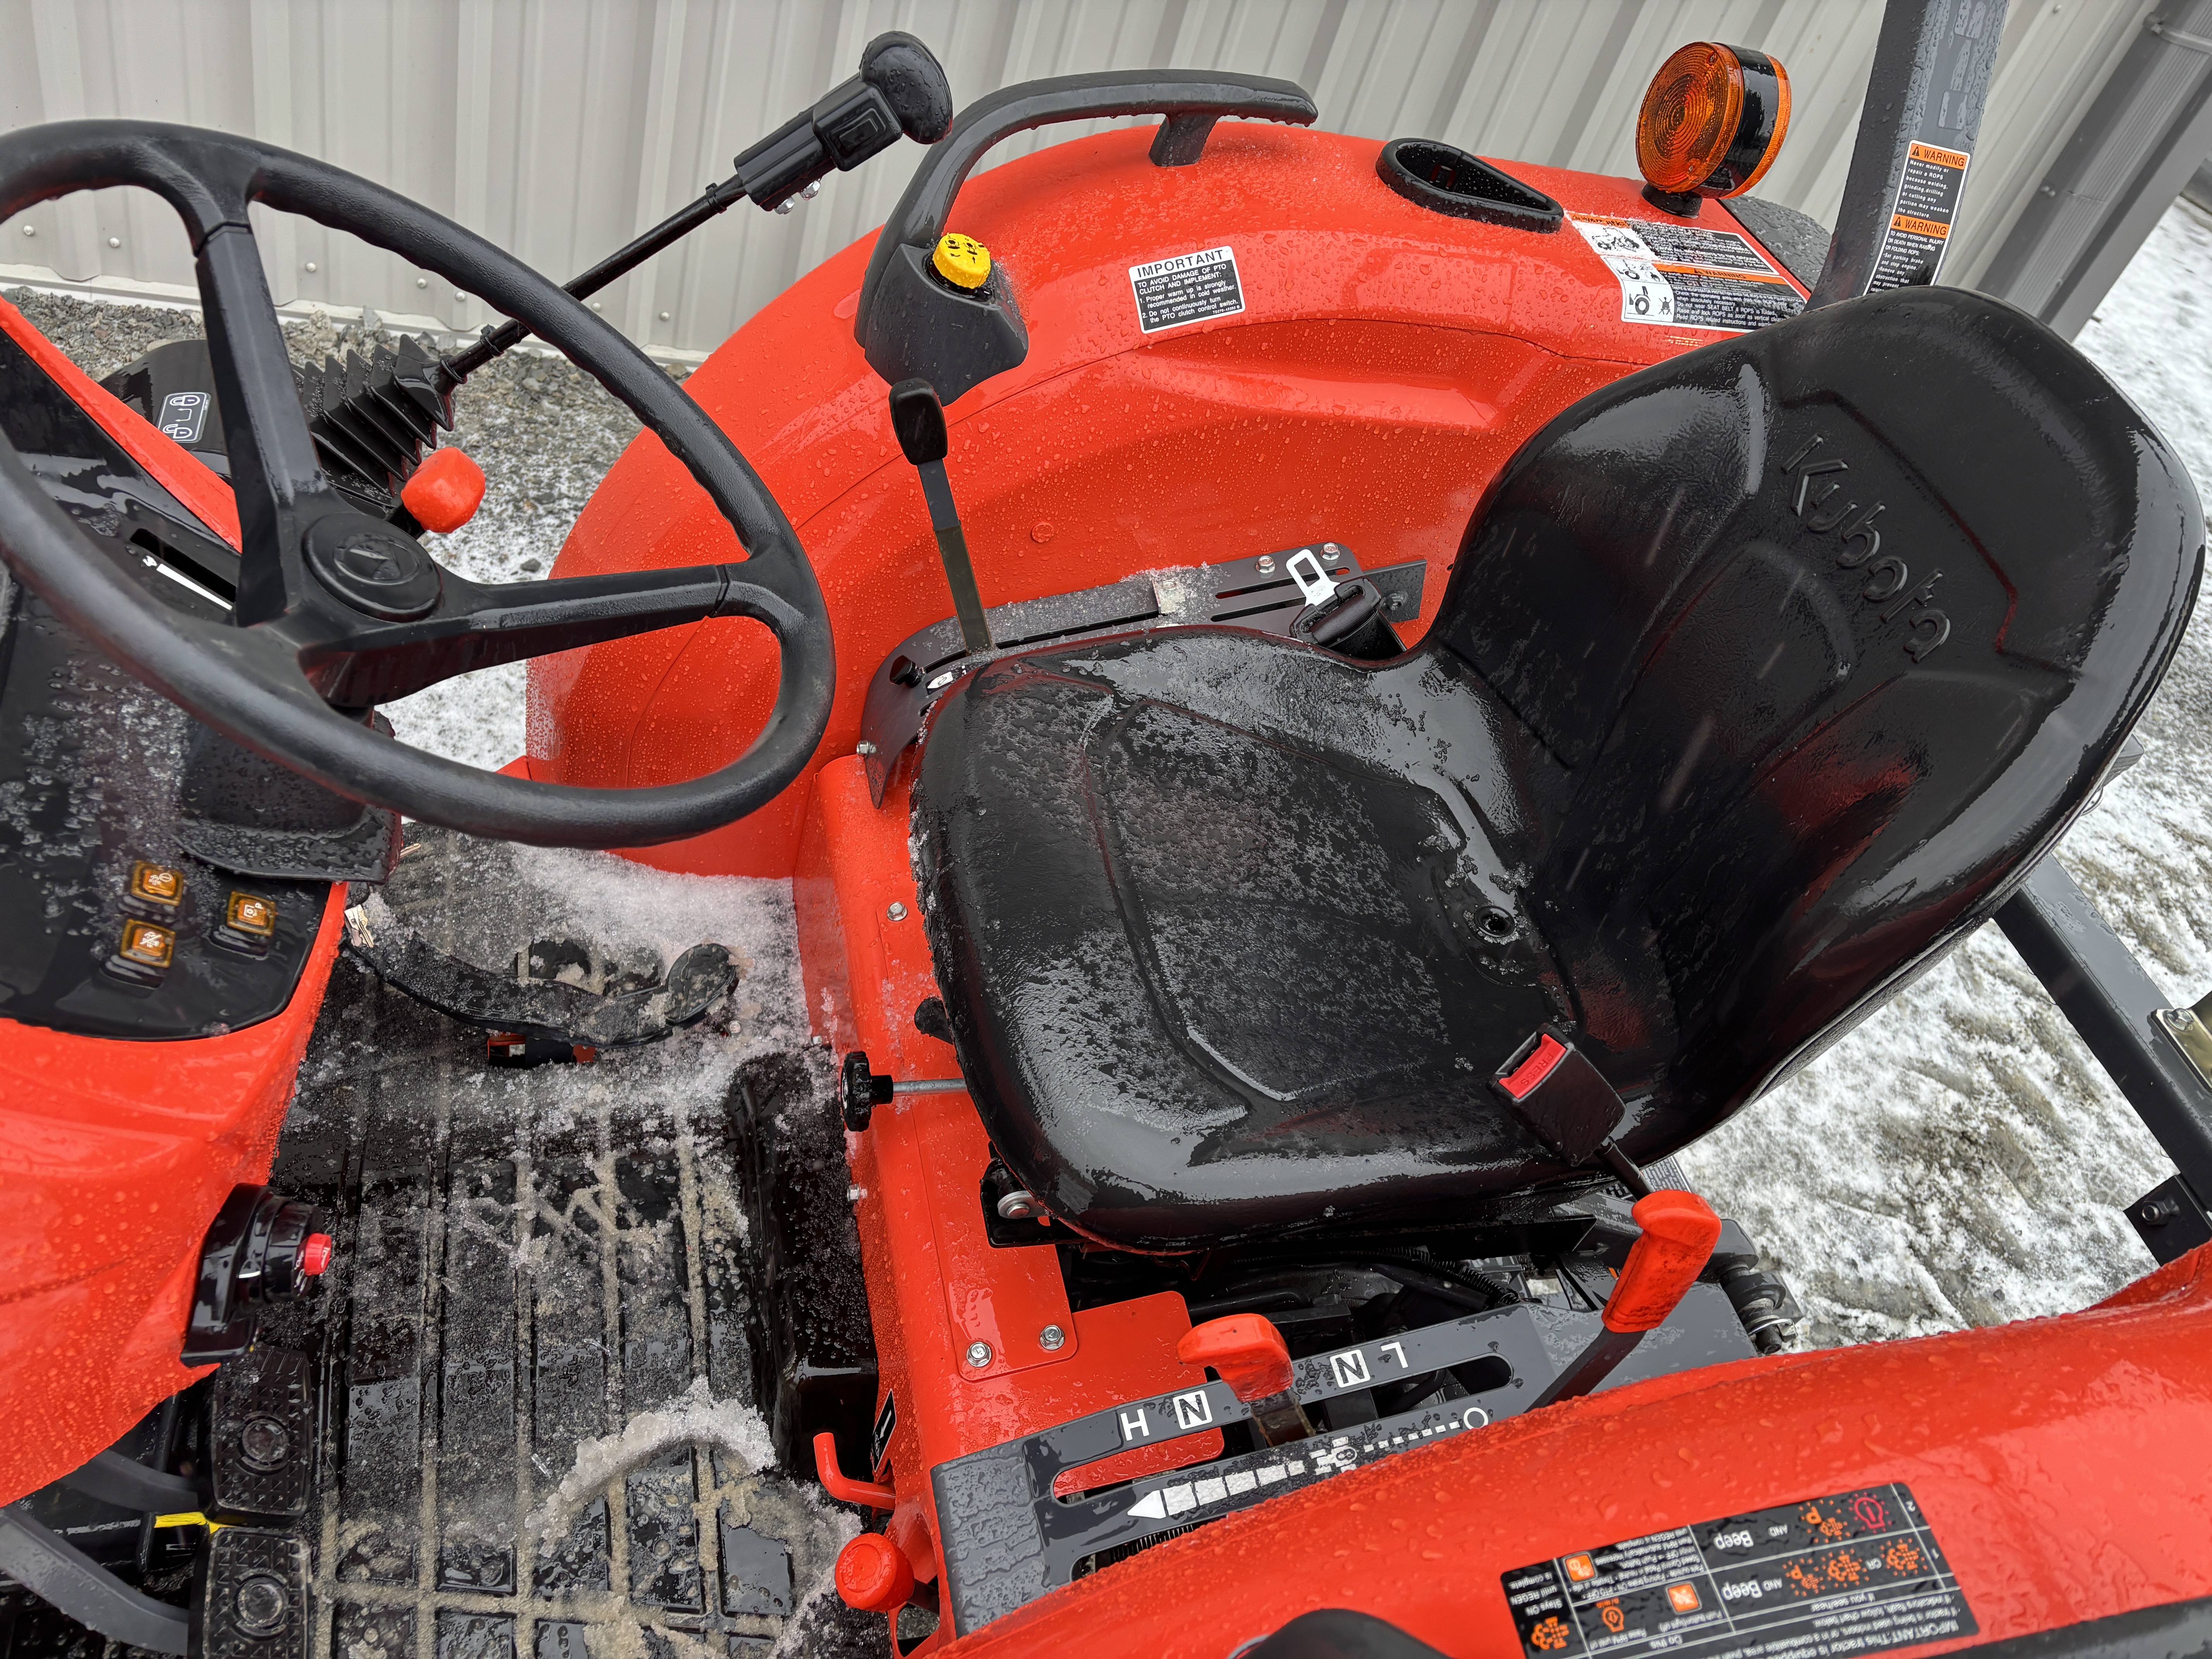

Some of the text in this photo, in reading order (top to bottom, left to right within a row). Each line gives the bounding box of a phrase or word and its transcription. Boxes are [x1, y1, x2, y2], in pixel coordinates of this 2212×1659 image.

[1925, 149, 1964, 166] WARNING
[1906, 175, 1948, 189] because welding,
[1907, 210, 1930, 218] structure.
[1906, 219, 1946, 235] WARNING
[1137, 250, 1222, 277] IMPORTANT
[1150, 276, 1169, 285] AVOID
[1172, 270, 1199, 280] DAMAGE
[1703, 270, 1746, 279] WARNING
[1140, 284, 1164, 295] CLUTCH
[1184, 271, 1221, 285] IMPLEMENT:
[1146, 294, 1164, 302] Proper
[1204, 280, 1226, 290] strongly
[1147, 295, 1187, 308] recommended
[1213, 285, 1236, 294] weather.
[1172, 299, 1206, 313] continuously
[1178, 308, 1195, 317] clutch
[1198, 303, 1216, 312] control
[1219, 299, 1238, 307] switch.
[1781, 433, 1951, 663] Kubota
[1520, 1053, 1554, 1086] PRESS
[1120, 1341, 1408, 1441] H N N L
[1714, 1501, 1915, 1549] 2 AND Beep
[1722, 1549, 1939, 1600] 1 OR AND Beep
[1510, 1585, 1557, 1605] until REGEN
[1848, 1592, 1867, 1603] you
[1526, 1598, 1562, 1616] Stays ON
[1811, 1597, 1849, 1612] see/hear
[1839, 1611, 1860, 1623] chart
[1860, 1607, 1884, 1618] follow
[1893, 1614, 1917, 1625] being
[1872, 1618, 1893, 1630] used
[1650, 1634, 1682, 1649] Do this
[1831, 1630, 1839, 1638] or
[1818, 1645, 1830, 1656] is
[1831, 1638, 1865, 1653] tractor
